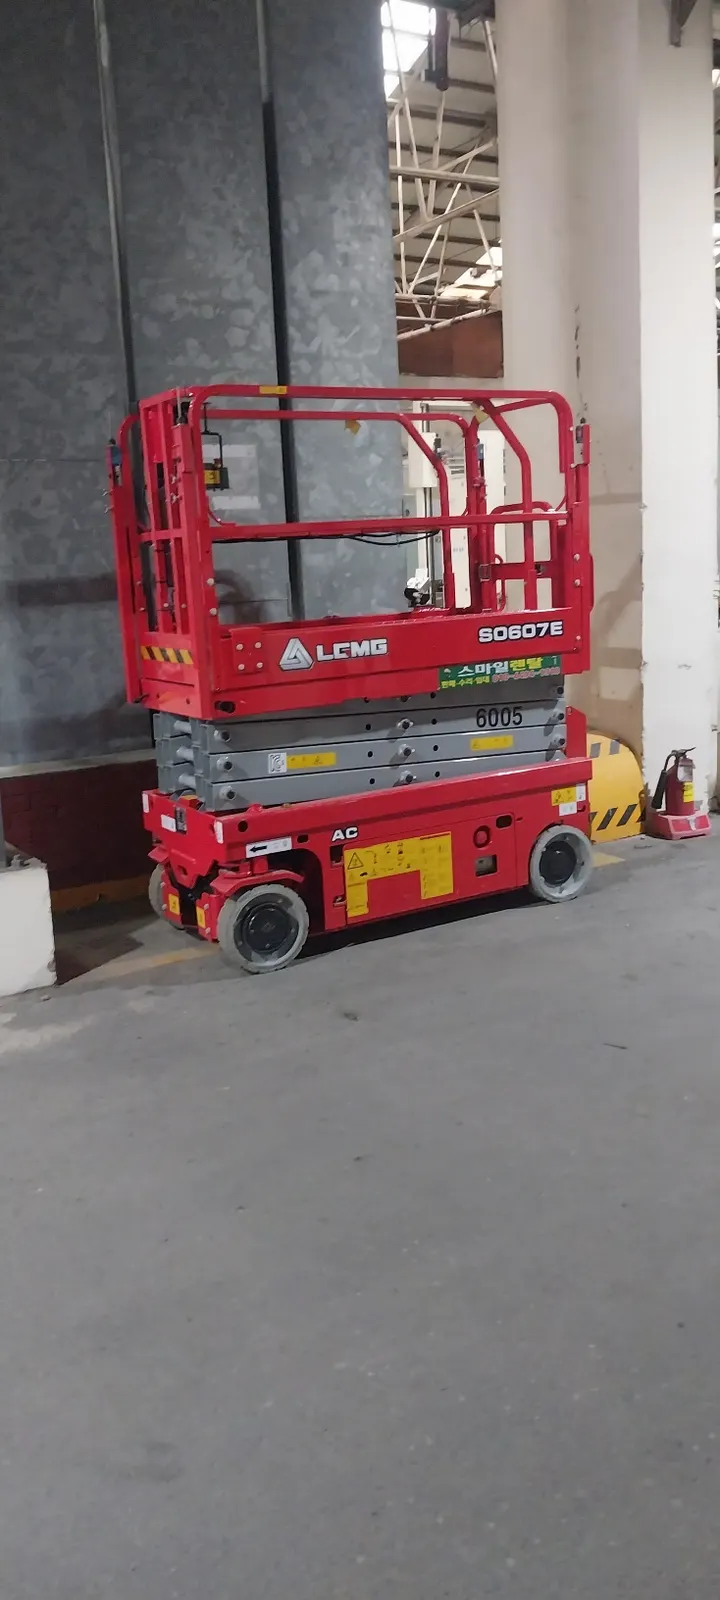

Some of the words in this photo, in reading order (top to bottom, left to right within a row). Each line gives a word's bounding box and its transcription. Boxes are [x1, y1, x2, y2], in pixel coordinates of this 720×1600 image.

[316, 638, 388, 662] LGMG
[457, 657, 543, 677] 스마일렌탈
[476, 706, 522, 728] 6005
[331, 826, 359, 842] AC
